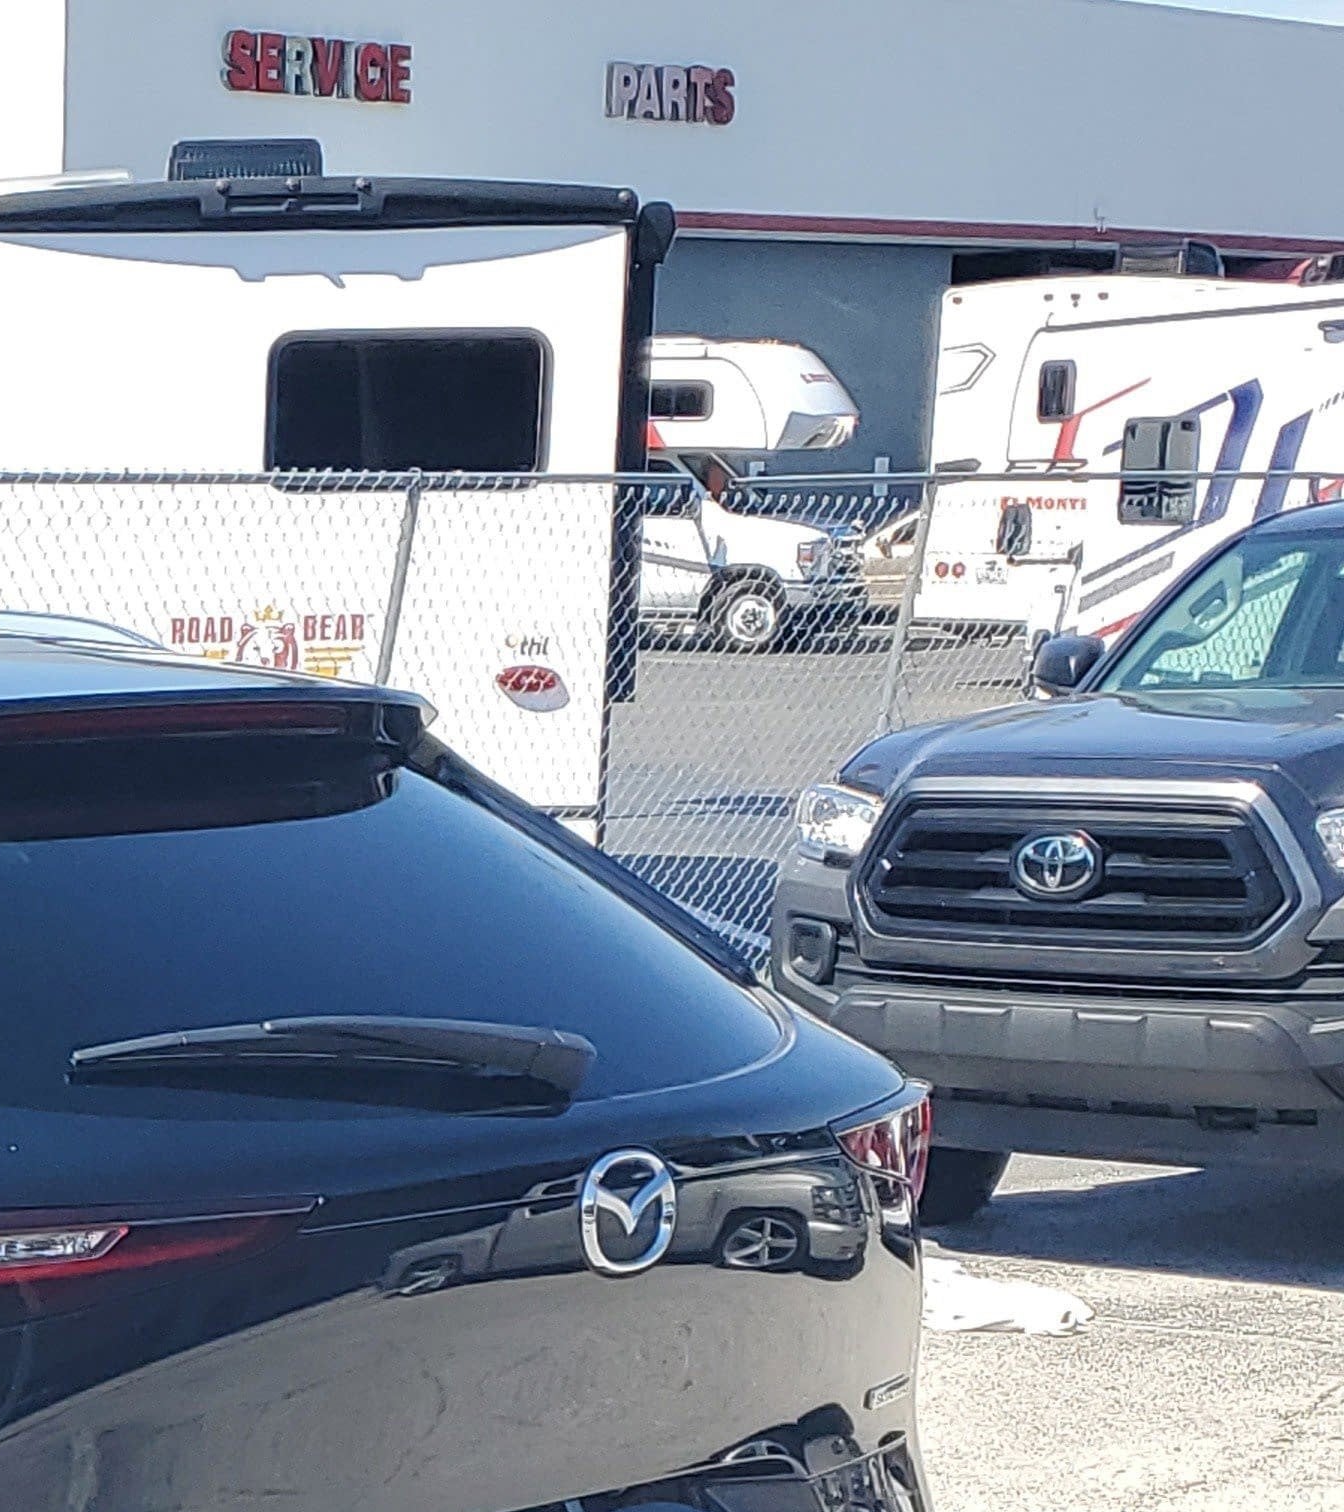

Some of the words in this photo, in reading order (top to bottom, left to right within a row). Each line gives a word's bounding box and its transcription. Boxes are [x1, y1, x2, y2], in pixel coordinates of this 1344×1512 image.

[221, 29, 412, 104] SERVICE
[604, 62, 735, 125] PARTS
[170, 616, 233, 645] ROAD
[303, 613, 365, 642] BEAR
